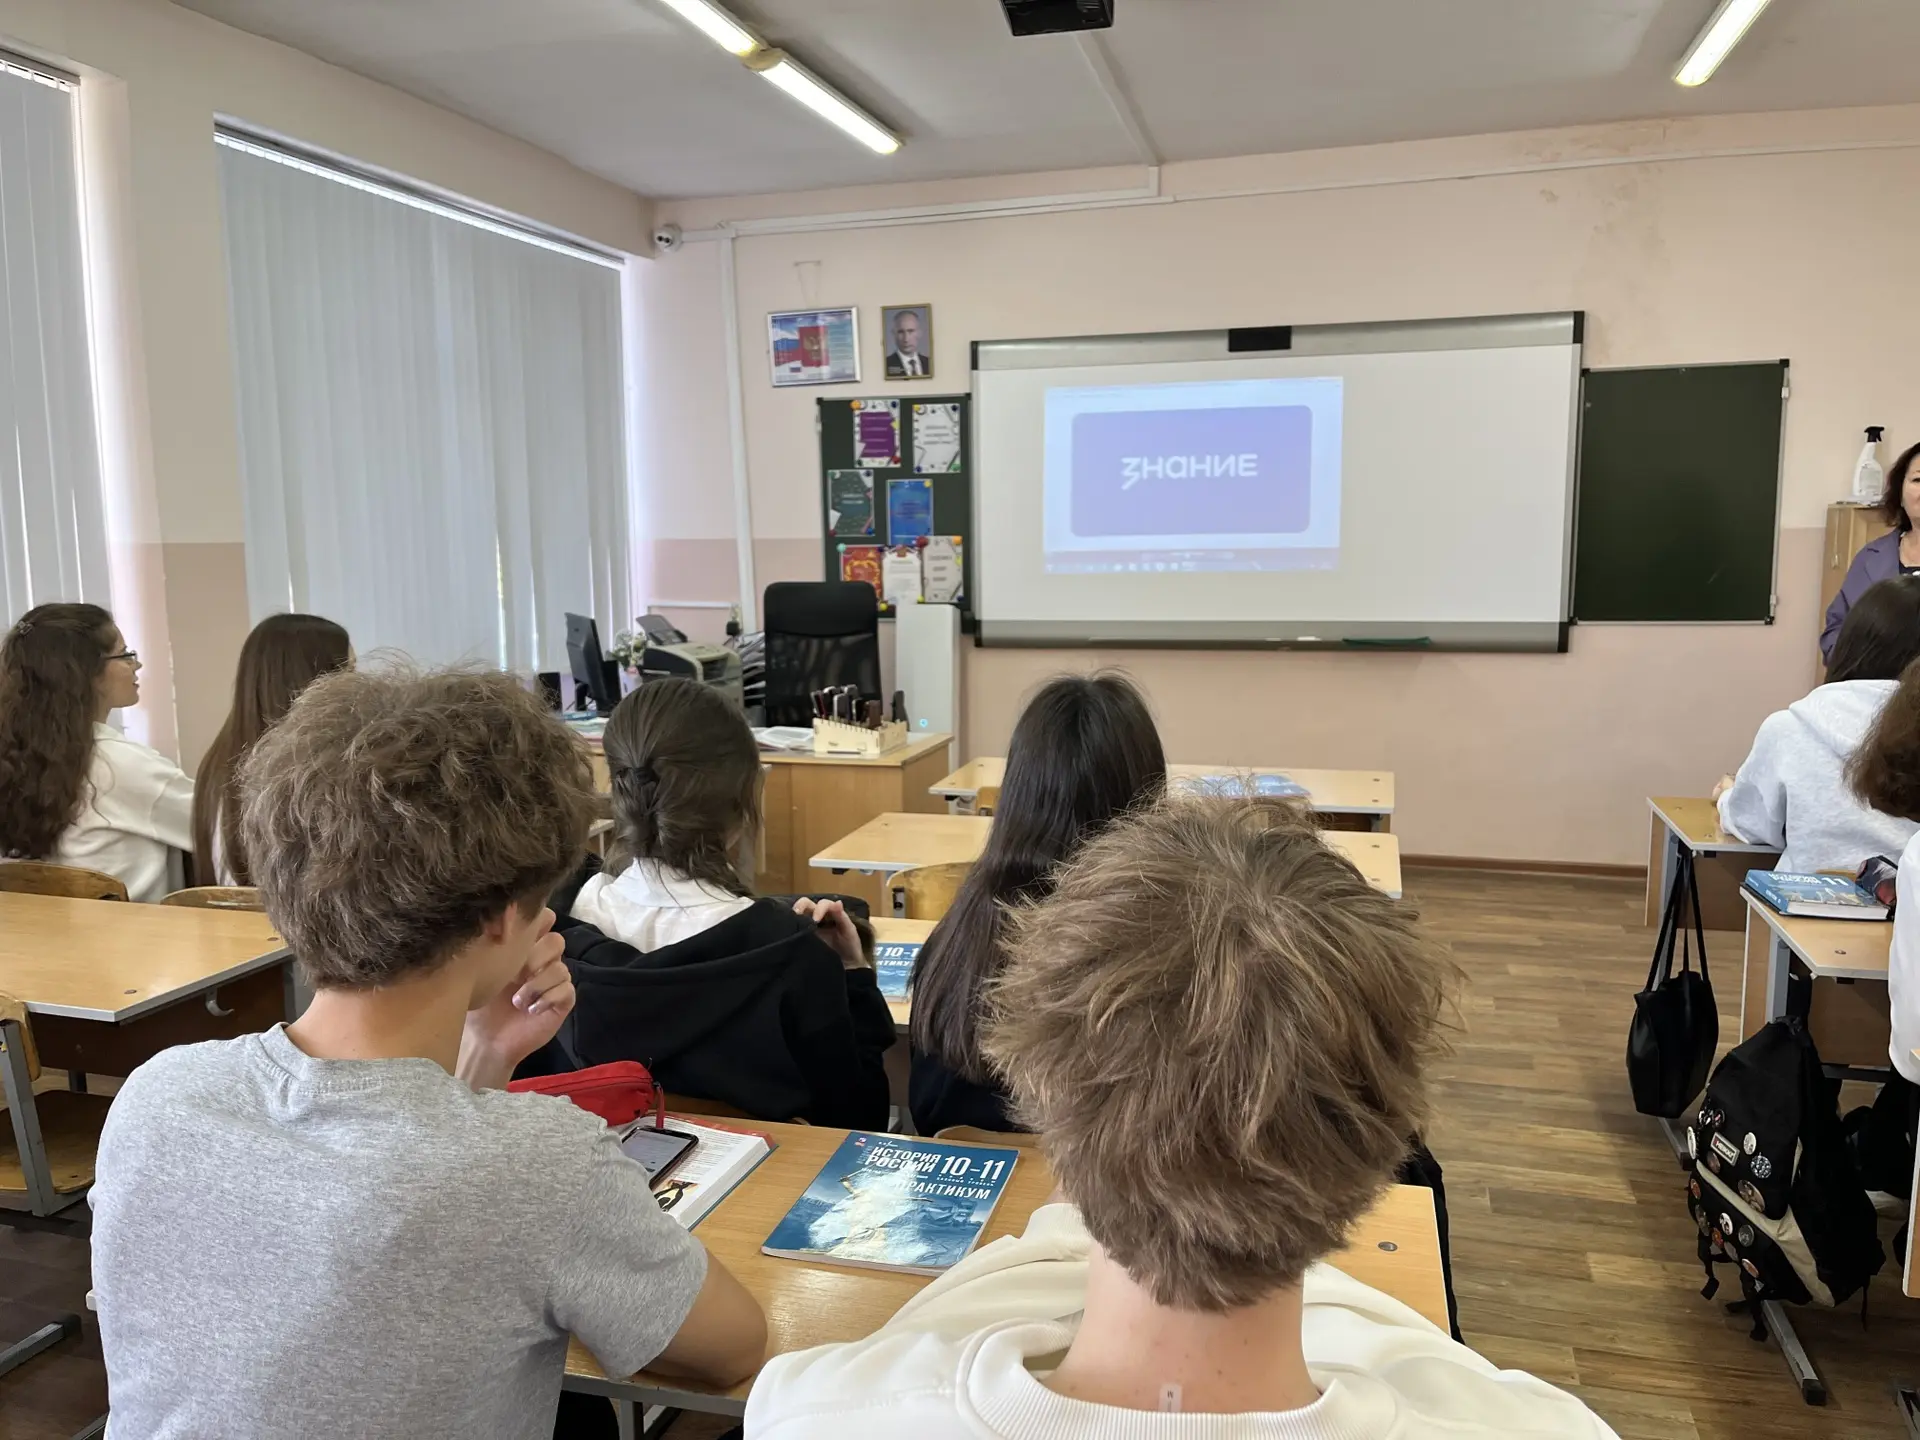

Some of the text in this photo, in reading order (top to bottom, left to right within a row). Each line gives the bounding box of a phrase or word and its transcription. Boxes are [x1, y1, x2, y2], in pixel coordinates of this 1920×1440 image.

[884, 946, 920, 957] 10-1
[865, 1154, 938, 1173] РОССИИ
[871, 1146, 942, 1163] ИСТОРИЯ
[940, 1156, 1006, 1180] 10-11
